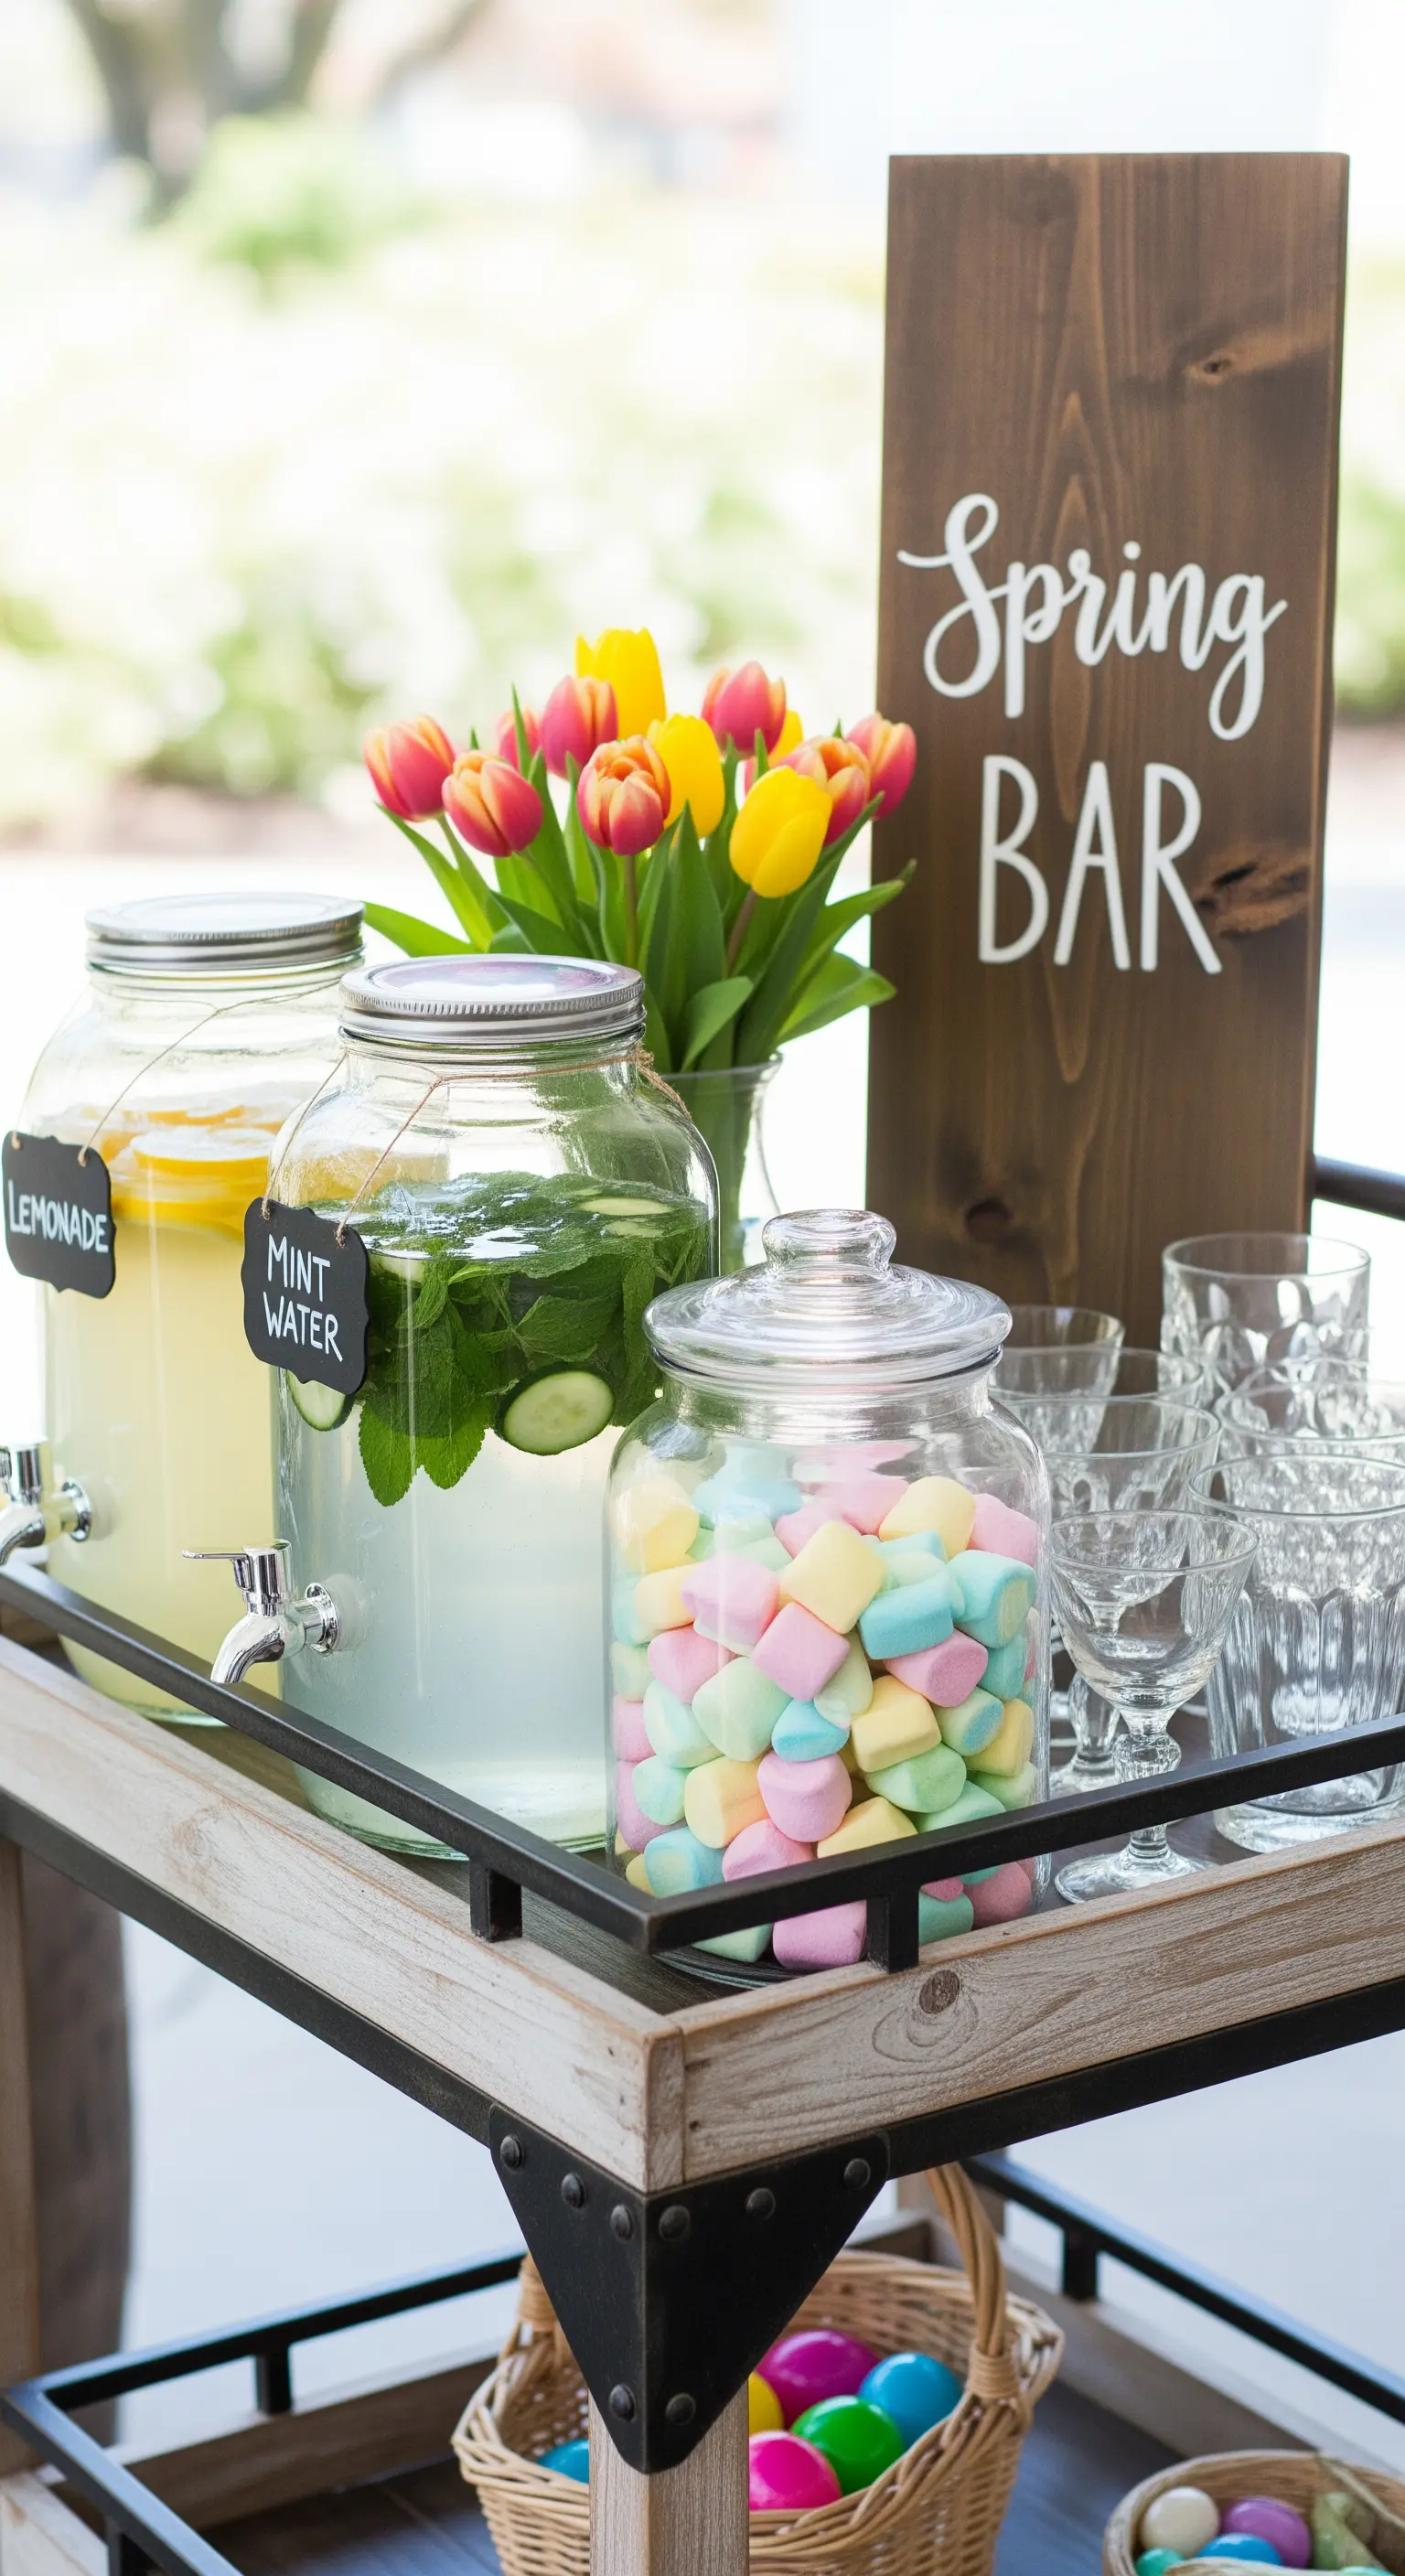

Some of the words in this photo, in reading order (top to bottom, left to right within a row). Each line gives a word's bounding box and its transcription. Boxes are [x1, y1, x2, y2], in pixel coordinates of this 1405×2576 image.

[896, 493, 1288, 741] Spring
[979, 756, 1222, 973] BAR
[7, 1178, 109, 1253] LEMONADE
[267, 1233, 331, 1303] MINT
[263, 1291, 344, 1363] WATER
